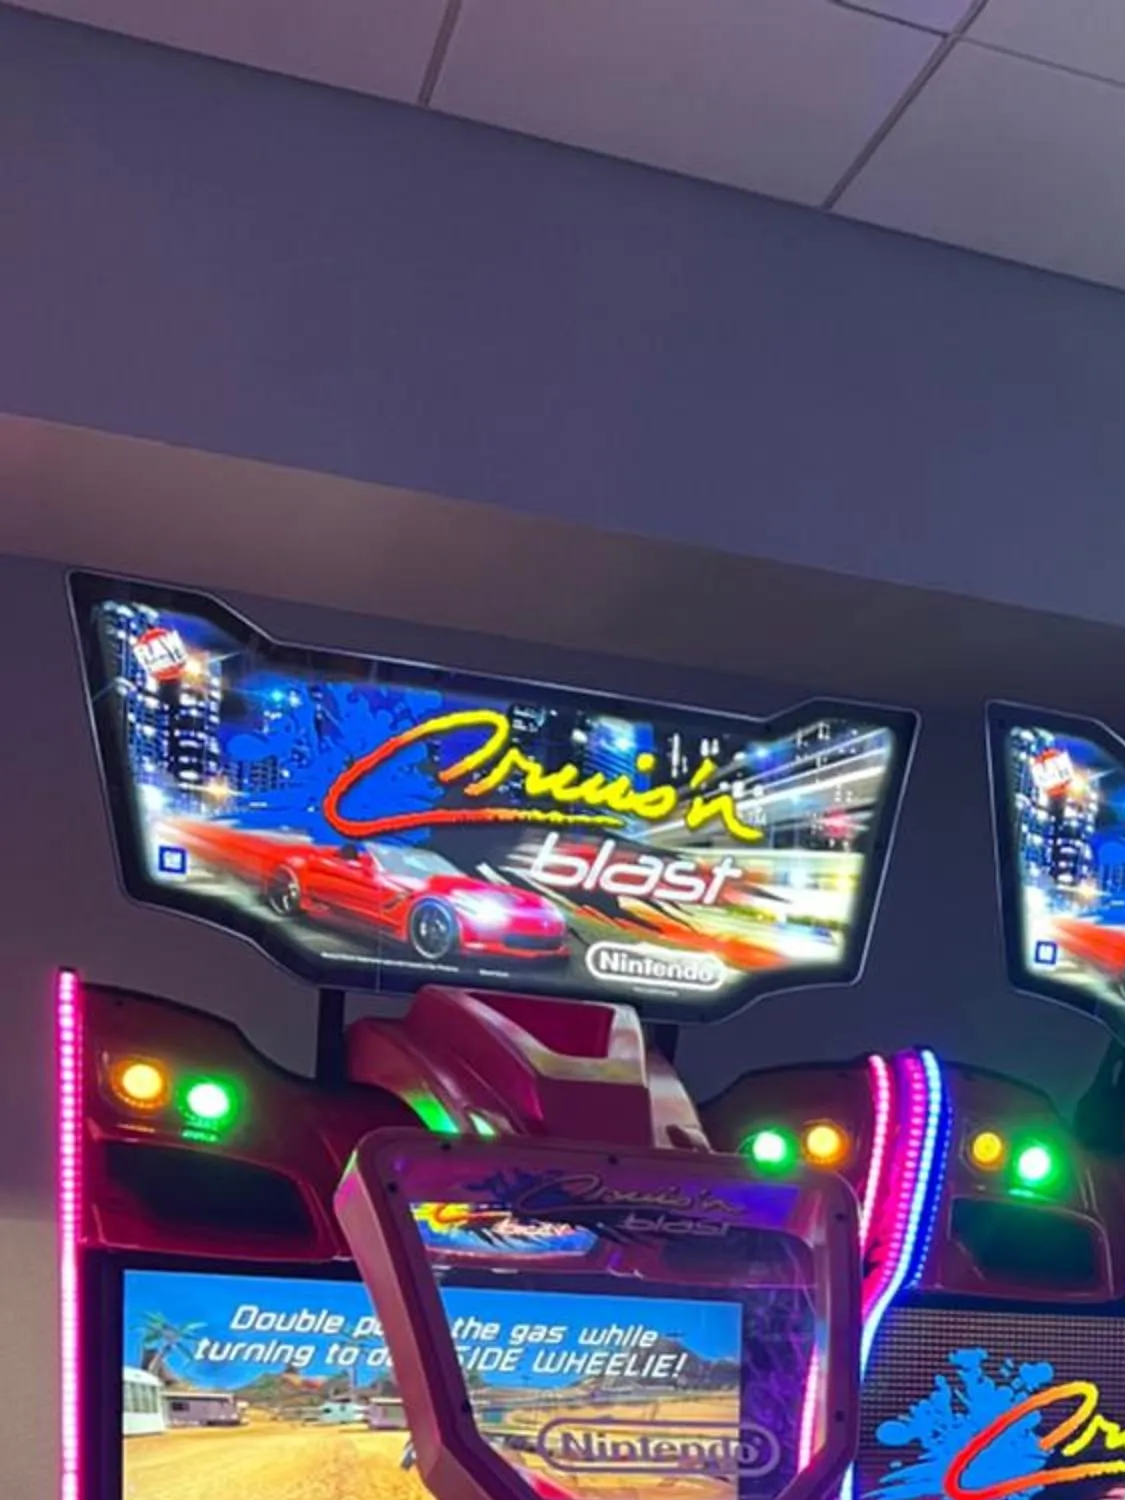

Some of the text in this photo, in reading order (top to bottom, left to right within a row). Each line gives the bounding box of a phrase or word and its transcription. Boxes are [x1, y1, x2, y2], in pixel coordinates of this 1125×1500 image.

[322, 709, 763, 840] Cruis'n
[529, 831, 743, 907] blast
[598, 949, 714, 983] Nintendo
[618, 1213, 732, 1236] blast
[230, 1304, 344, 1333] Double
[451, 1316, 500, 1341] the
[510, 1324, 568, 1345] gas
[579, 1324, 659, 1347] while
[194, 1337, 315, 1367] turning
[325, 1342, 359, 1366] to
[533, 1350, 688, 1378] WHEELIE!
[561, 1431, 760, 1464] Nintendo
